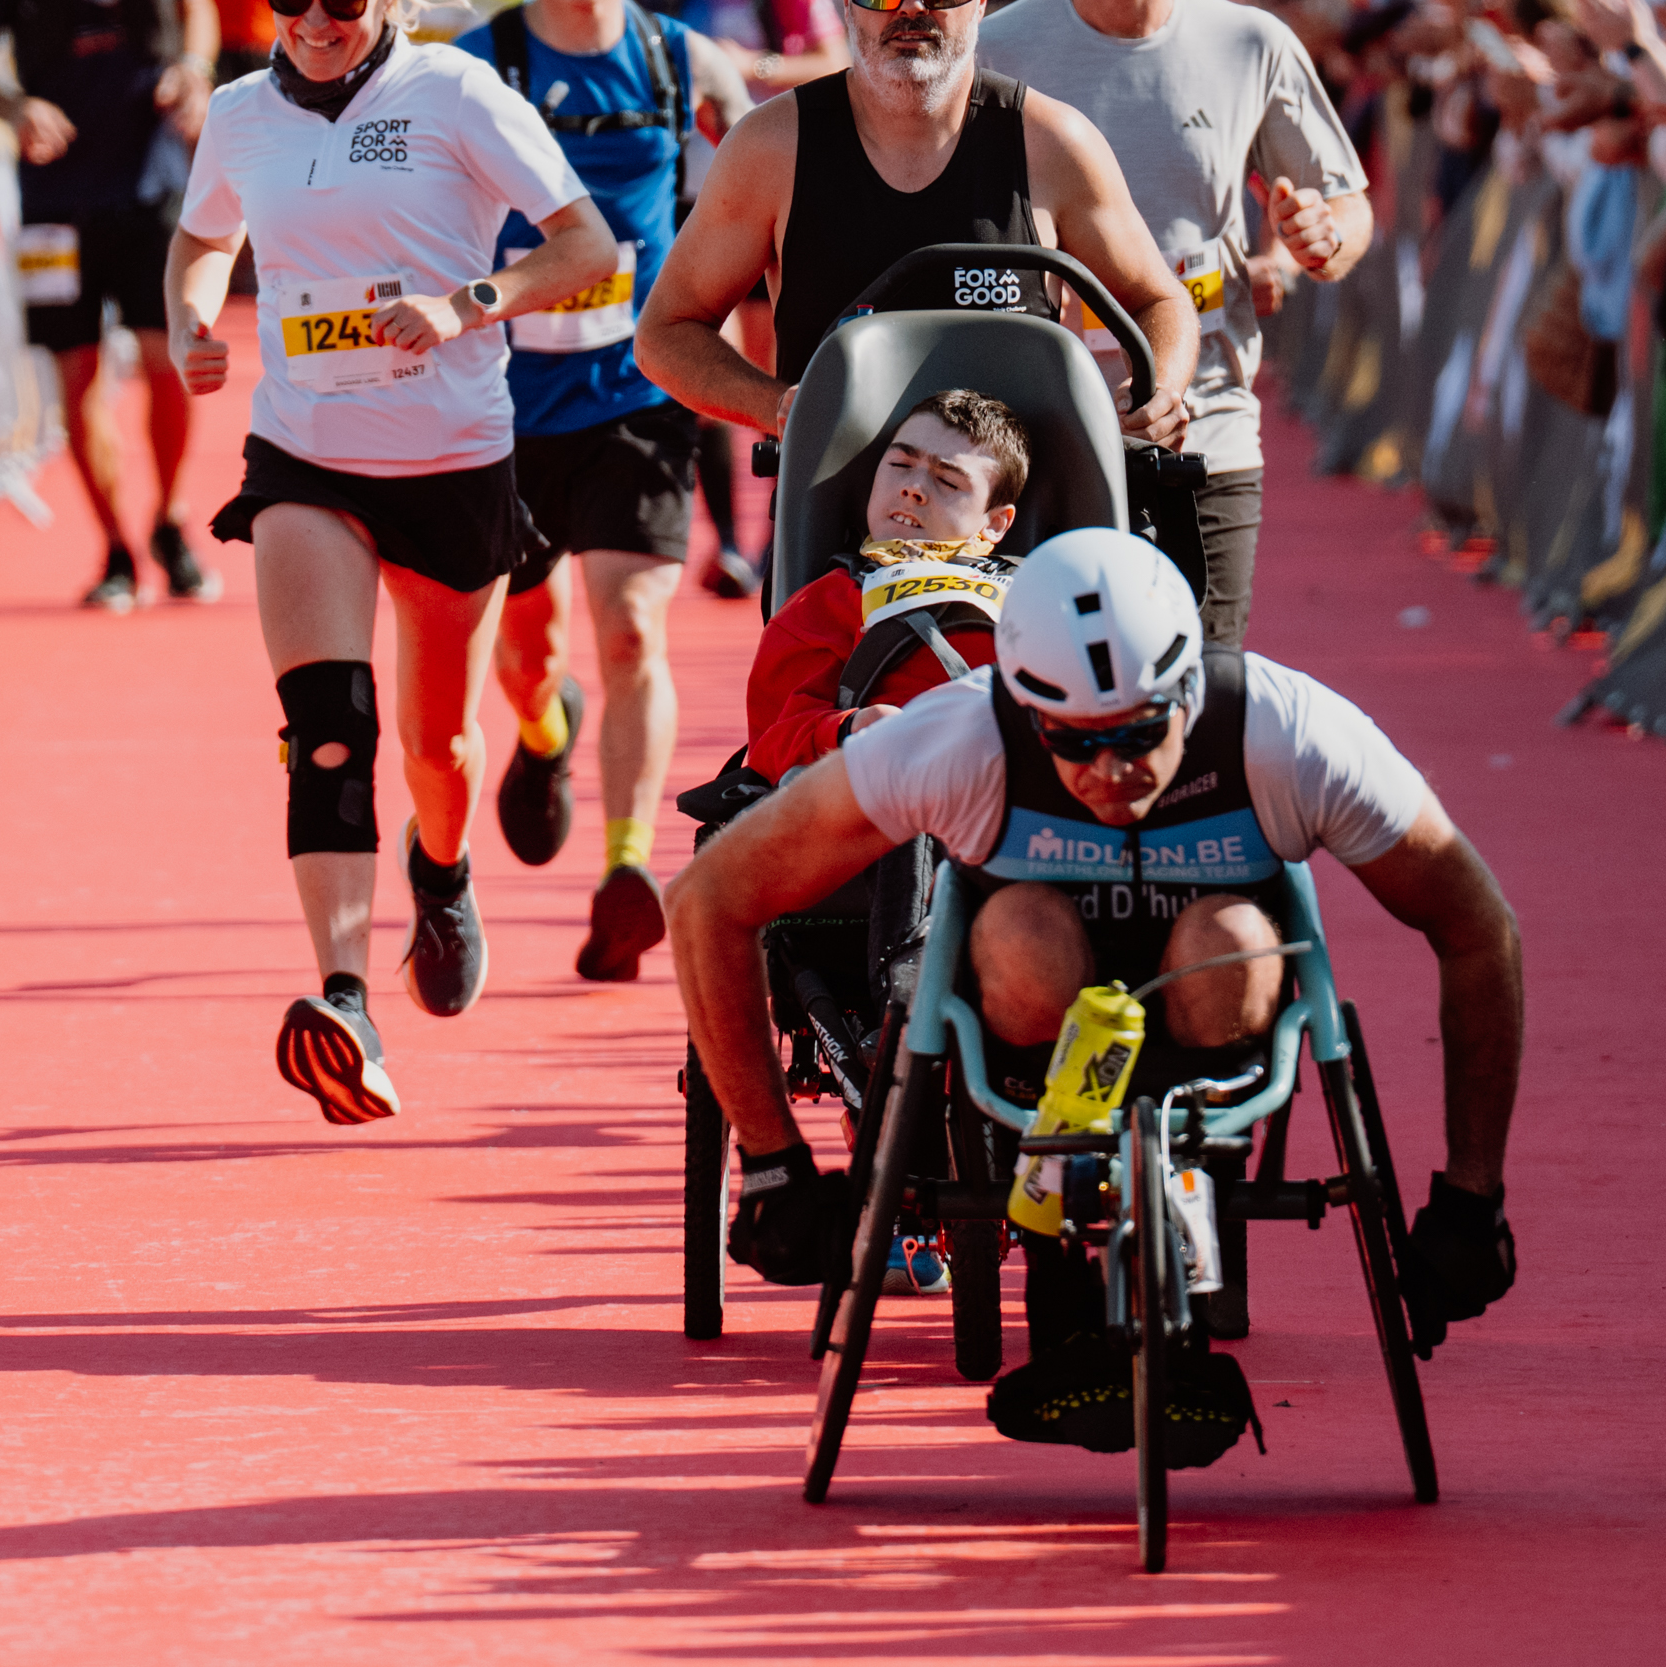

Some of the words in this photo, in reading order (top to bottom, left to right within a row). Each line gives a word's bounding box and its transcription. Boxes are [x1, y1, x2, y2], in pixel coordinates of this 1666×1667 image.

[354, 119, 412, 135] SPORT
[351, 133, 386, 149] FOR
[349, 148, 408, 163] GOOD
[954, 268, 998, 288] FOR
[954, 285, 1021, 306] GOOD
[301, 312, 377, 352] 1243
[392, 364, 425, 379] 12437
[884, 576, 1000, 604] 12530
